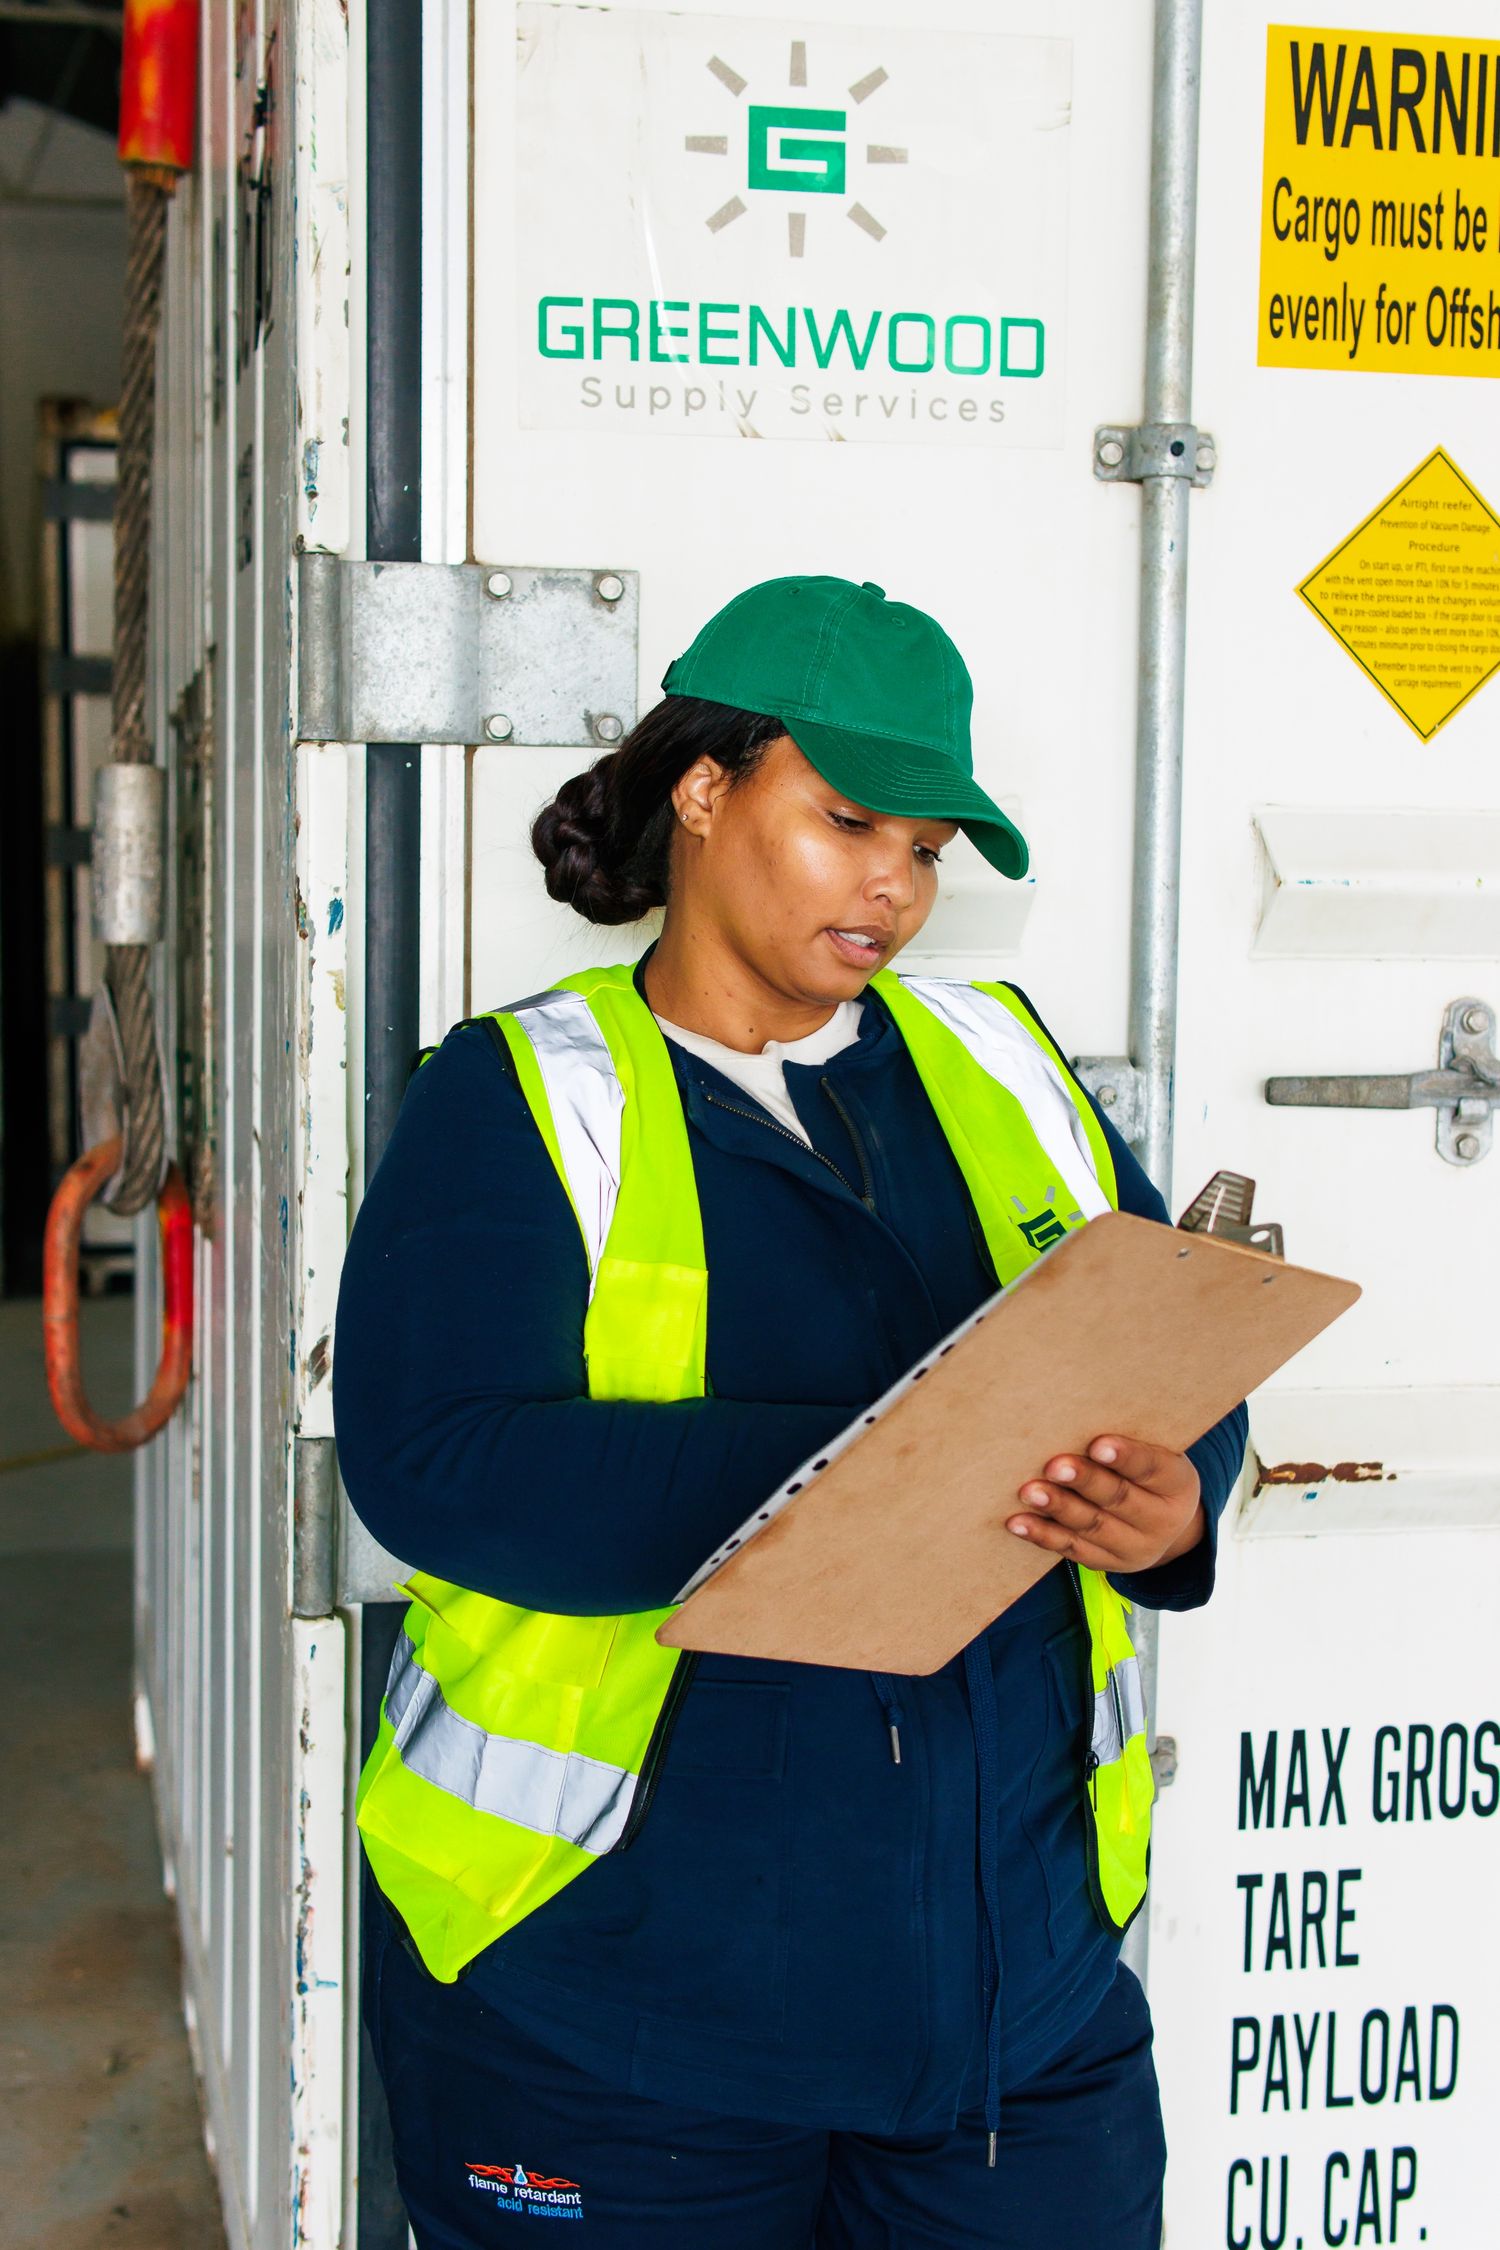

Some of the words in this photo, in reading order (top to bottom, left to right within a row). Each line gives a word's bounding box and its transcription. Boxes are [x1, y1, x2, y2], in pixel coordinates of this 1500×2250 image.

[1272, 176, 1361, 261] Cargo
[1371, 190, 1444, 251] must
[1454, 188, 1488, 253] be
[1269, 281, 1366, 360] evenly
[1376, 282, 1417, 346] for
[537, 295, 1046, 378] GREENWOOD
[580, 376, 758, 419] Supply
[789, 383, 1007, 423] Services
[1400, 499, 1438, 511] Airtight
[1443, 501, 1472, 511] reefer
[1380, 518, 1418, 529] Prevention
[1420, 520, 1428, 530] of
[1430, 521, 1459, 531] Vacuum
[1461, 522, 1491, 535] Damage
[1409, 540, 1460, 552] Procedure
[1360, 559, 1371, 570] On
[1373, 561, 1390, 571] start
[1431, 562, 1446, 572] first
[1448, 565, 1460, 573] run
[1462, 565, 1474, 574] the
[1325, 575, 1341, 584] with
[1343, 575, 1355, 585] the
[1357, 576, 1373, 585] vent
[1375, 578, 1393, 587] open
[1395, 579, 1413, 588] more
[1416, 579, 1433, 588] than
[1451, 579, 1461, 589] for
[1471, 582, 1500, 592] minutes
[1320, 592, 1329, 600] to
[1331, 590, 1359, 601] relieve
[1361, 592, 1375, 601] the
[1377, 594, 1413, 604] pressure
[1415, 596, 1424, 604] as
[1427, 595, 1440, 605] the
[1443, 597, 1477, 608] changes
[1391, 610, 1413, 618] loaded
[1414, 610, 1426, 620] box
[1440, 611, 1450, 621] the
[1451, 612, 1469, 624] cargo
[1471, 612, 1485, 622] door
[1341, 624, 1353, 635] any
[1354, 624, 1378, 633] reason
[1385, 625, 1400, 634] also
[1401, 626, 1419, 636] open
[1420, 627, 1431, 636] the
[1433, 627, 1448, 637] vent
[1449, 628, 1467, 637] more
[1468, 628, 1484, 638] than
[1352, 639, 1377, 649] minutes
[1379, 640, 1409, 650] minimum
[1410, 641, 1426, 653] prior
[1427, 642, 1434, 652] to
[1435, 642, 1458, 654] closing
[1459, 643, 1469, 654] the
[1471, 644, 1489, 656] cargo
[1374, 660, 1408, 672] Remember
[1409, 662, 1416, 671] to
[1417, 662, 1437, 672] return
[1438, 662, 1449, 672] the
[1450, 663, 1464, 673] vent
[1465, 664, 1472, 673] to
[1473, 663, 1484, 674] the
[1394, 678, 1419, 690] carriage
[1421, 679, 1462, 690] requirements
[1237, 1727, 1351, 1831] MAX
[1236, 1868, 1363, 1973] TARE
[1229, 2003, 1460, 2115] PAYLOAD
[468, 2174, 509, 2195] flame
[514, 2186, 583, 2205] retardant
[1226, 2154, 1304, 2250] CU.
[1322, 2145, 1428, 2248] CAP.
[497, 2195, 523, 2212] acid
[528, 2203, 584, 2219] resistant
